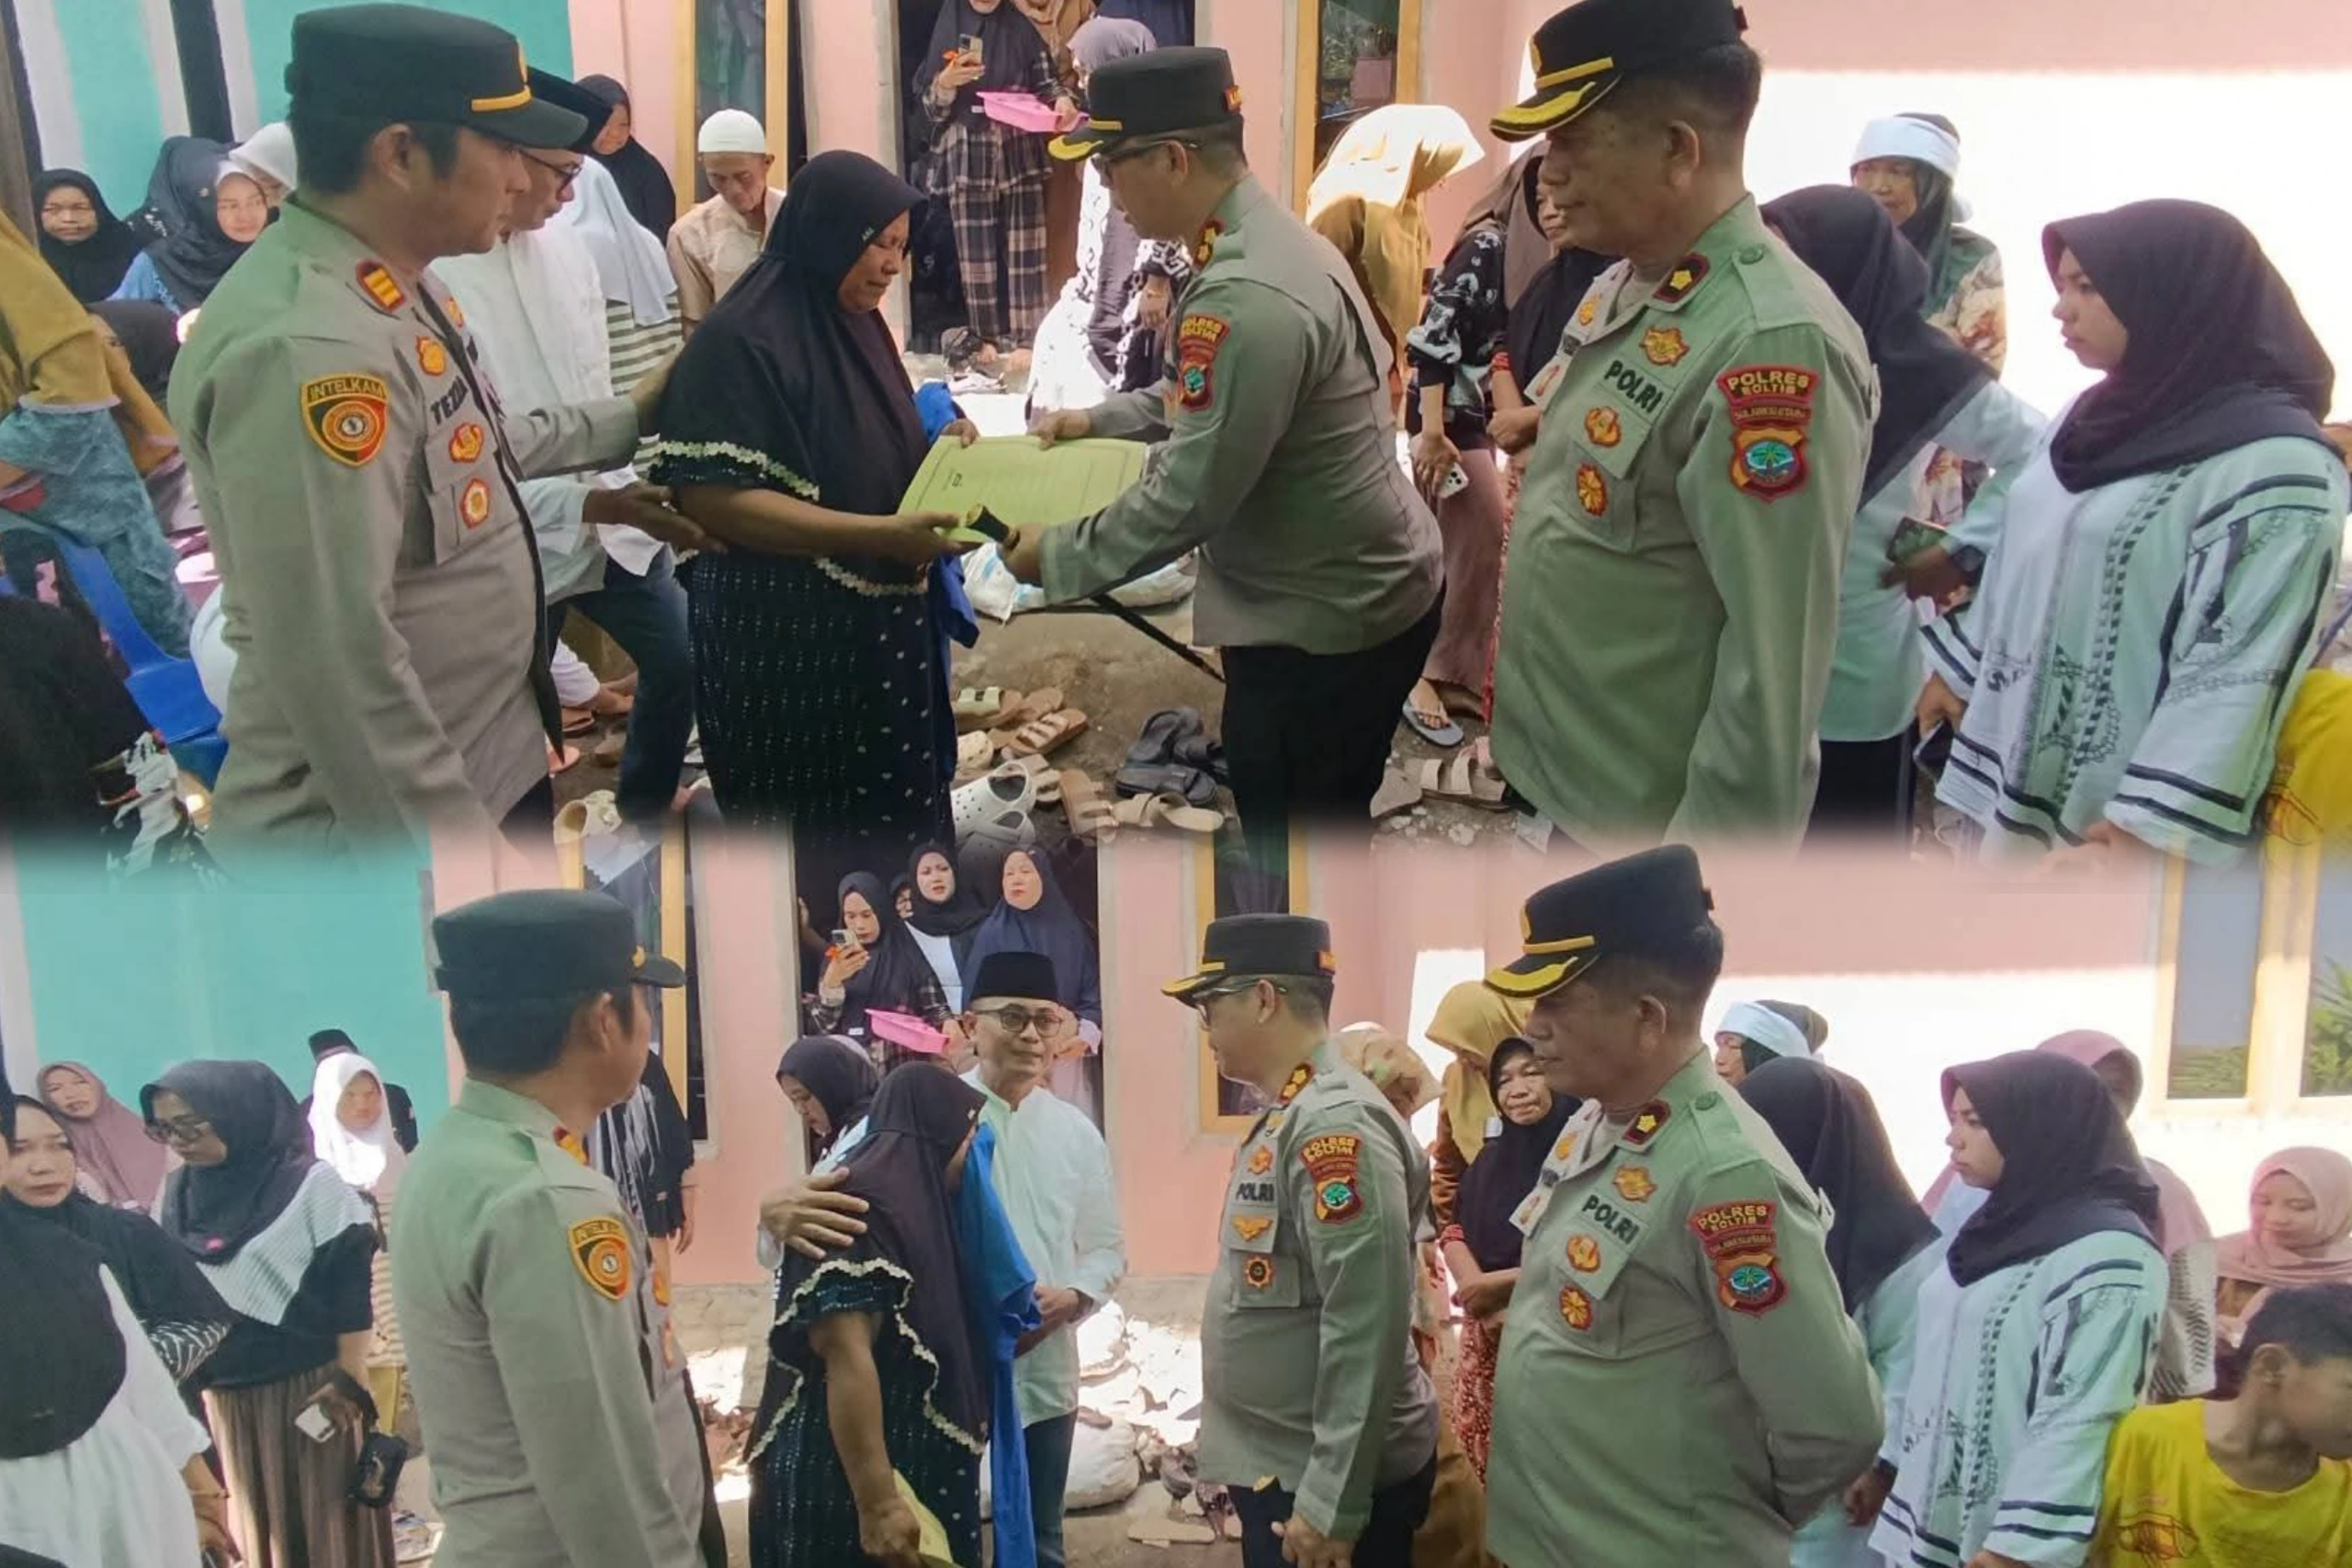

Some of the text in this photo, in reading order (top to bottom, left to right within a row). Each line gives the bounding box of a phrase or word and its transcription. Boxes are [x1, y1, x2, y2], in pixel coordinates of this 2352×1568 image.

[309, 377, 385, 400] INTELKAM
[1604, 359, 1664, 414] POLRI
[1727, 371, 1809, 390] POLRES
[1582, 1195, 1640, 1245] POLRI
[1697, 1206, 1767, 1230] POLRES
